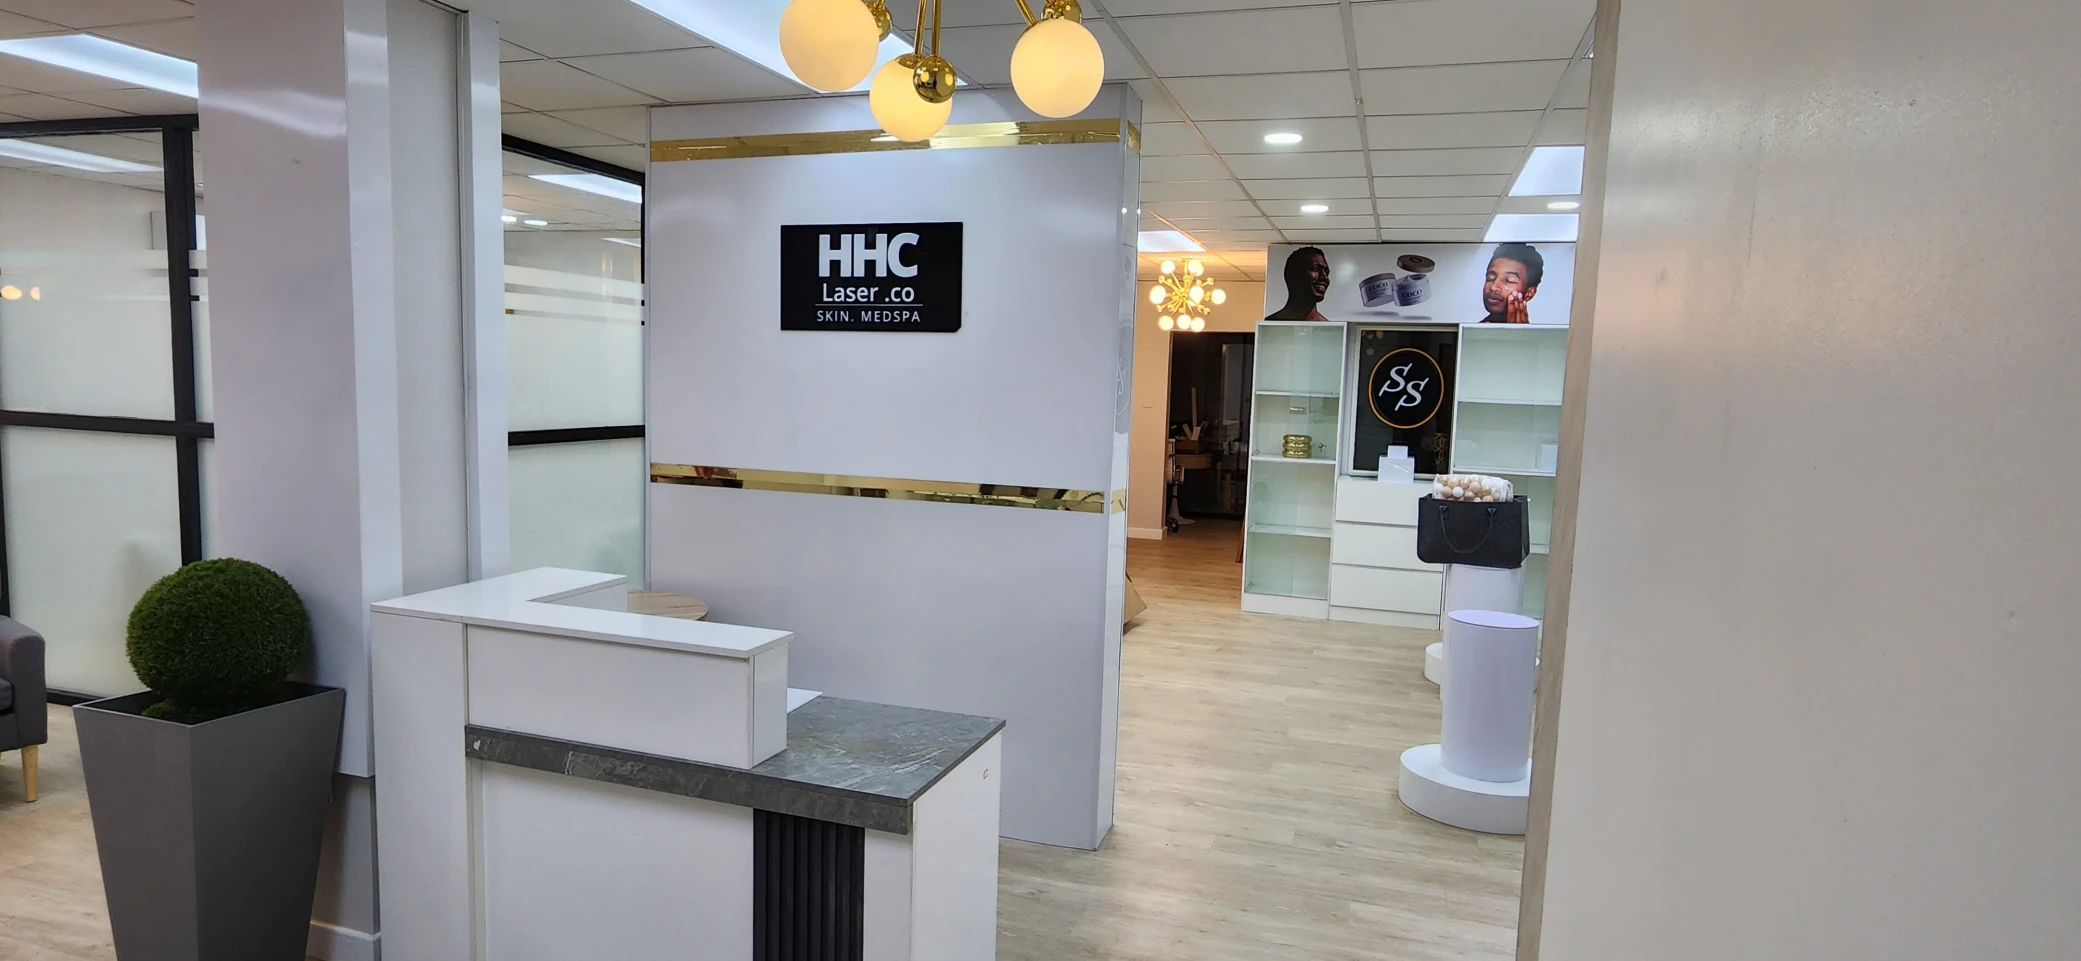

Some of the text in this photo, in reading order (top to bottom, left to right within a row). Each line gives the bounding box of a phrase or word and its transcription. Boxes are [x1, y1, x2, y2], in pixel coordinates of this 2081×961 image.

[818, 232, 920, 278] HHC
[822, 282, 915, 303] Laser .co
[1401, 288, 1423, 299] COCO
[816, 310, 921, 323] SKIN. MEDSPA
